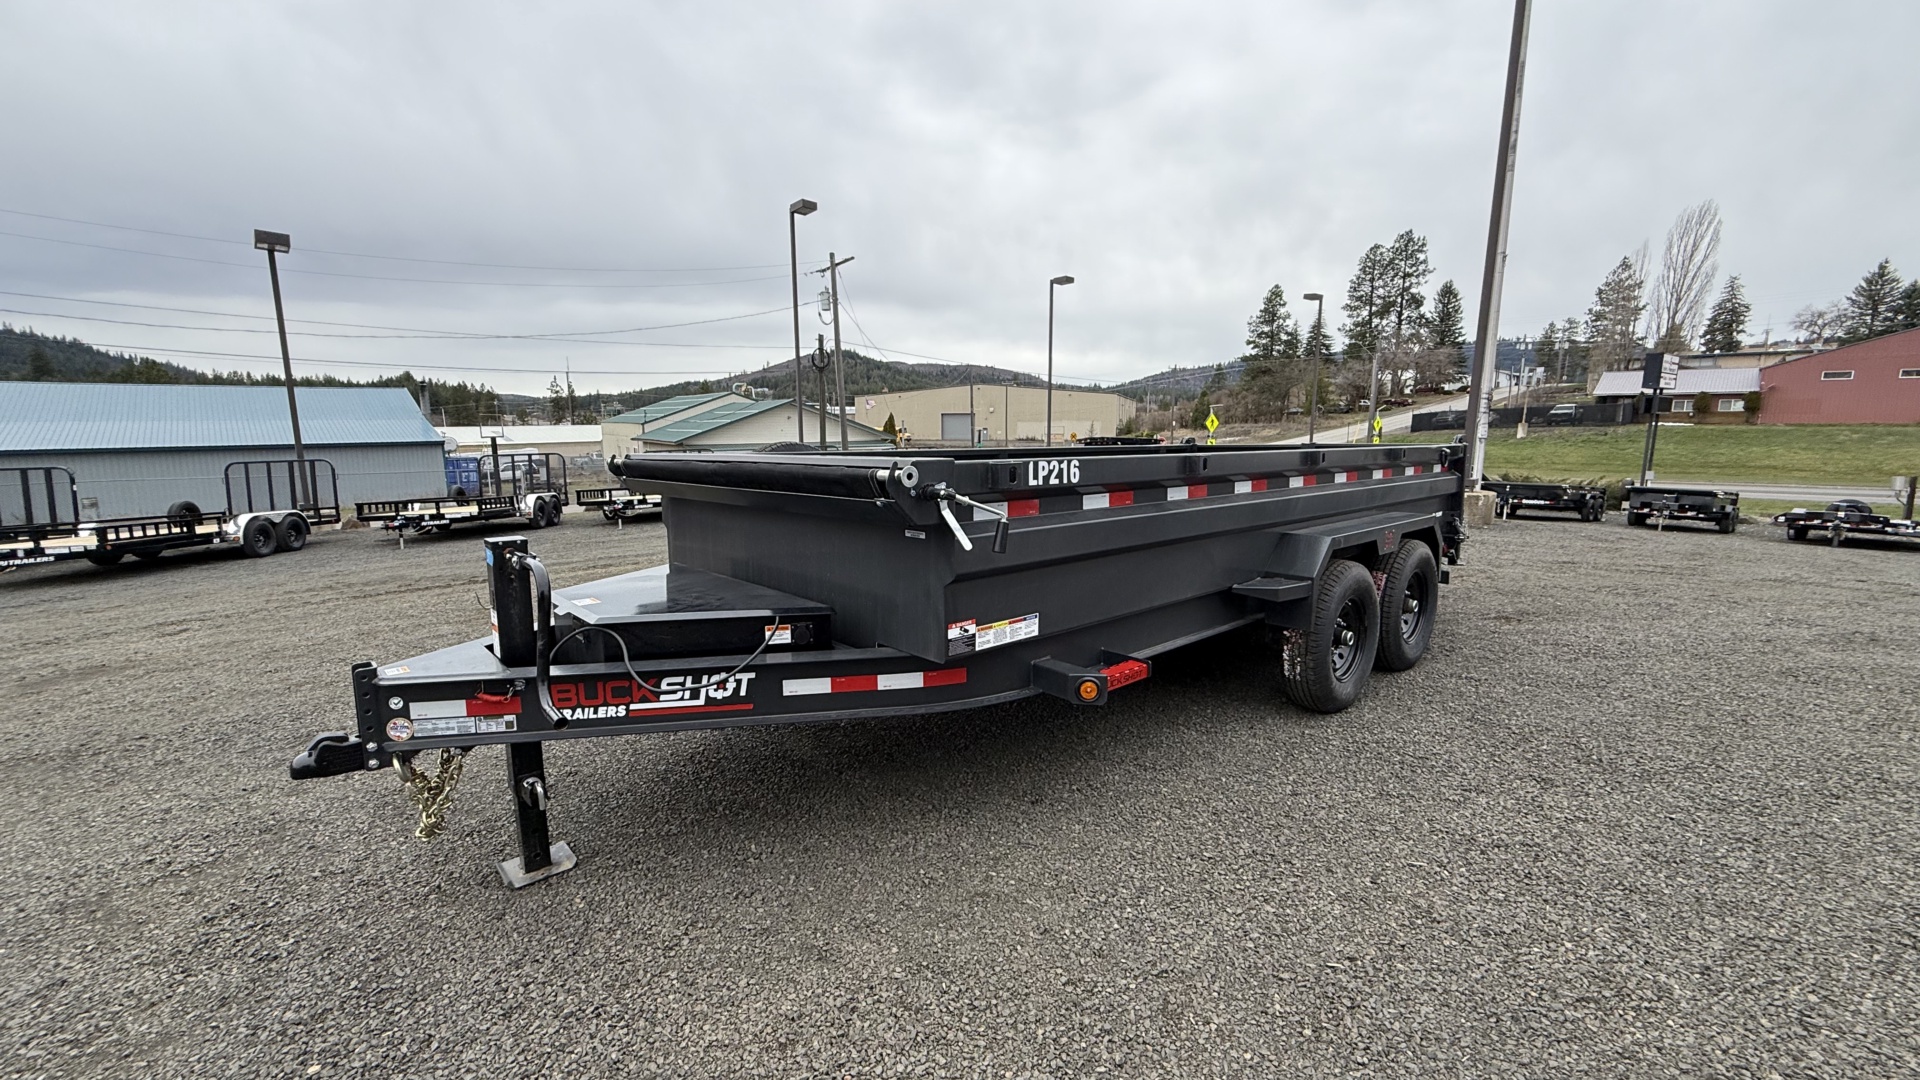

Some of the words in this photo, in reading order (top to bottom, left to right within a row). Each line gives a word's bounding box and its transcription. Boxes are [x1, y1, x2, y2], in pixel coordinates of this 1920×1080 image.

[1028, 459, 1080, 486] LP216
[9, 556, 55, 565] TRAILERS
[560, 705, 627, 721] RAILERS
